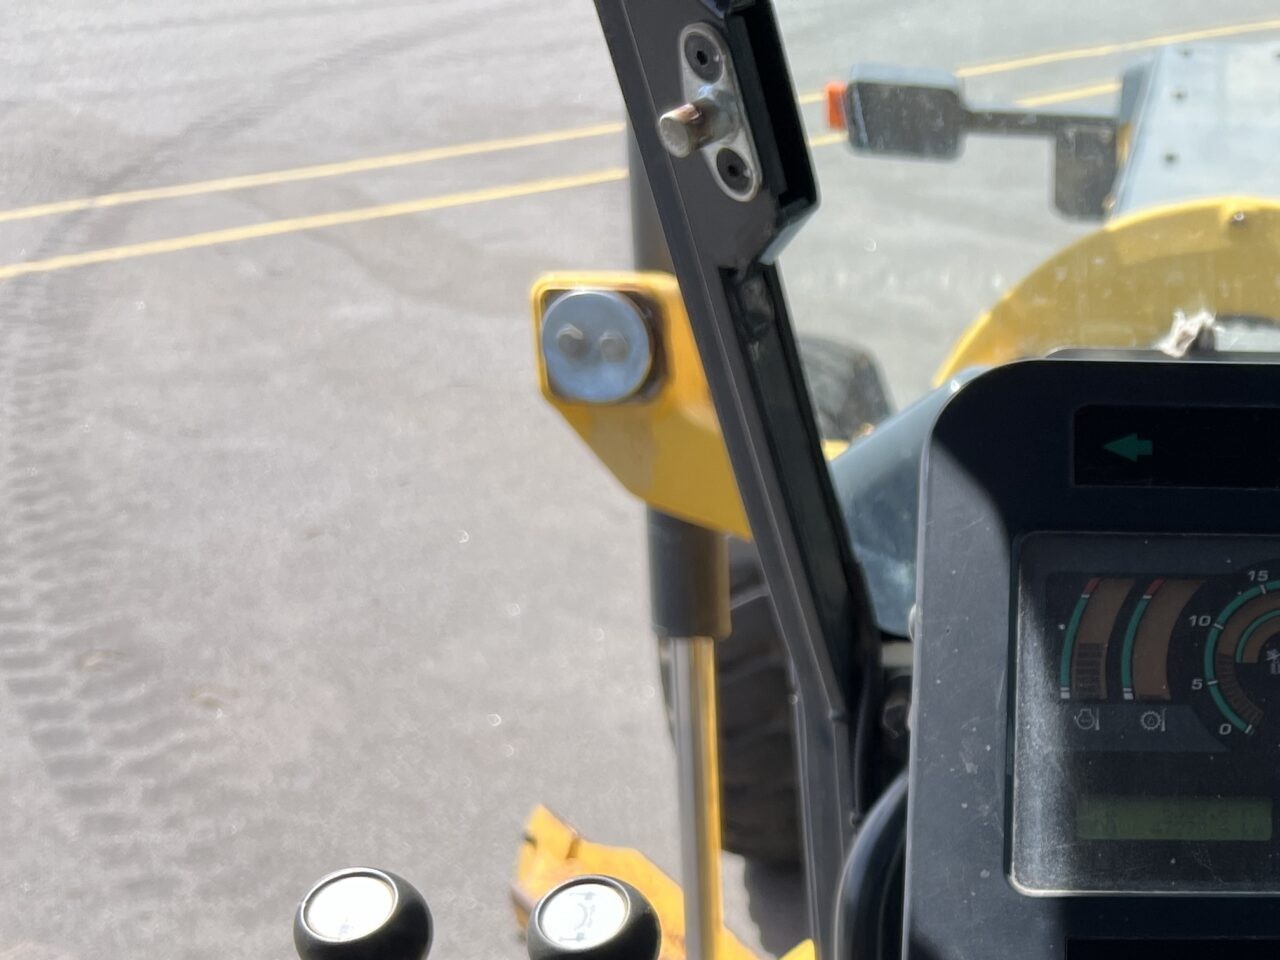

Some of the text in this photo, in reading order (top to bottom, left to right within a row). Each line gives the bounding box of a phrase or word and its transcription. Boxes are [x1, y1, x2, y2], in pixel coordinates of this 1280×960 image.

[1247, 570, 1269, 582] 15
[1188, 616, 1211, 628] 10
[1191, 678, 1203, 690] 5
[1219, 723, 1232, 736] 0
